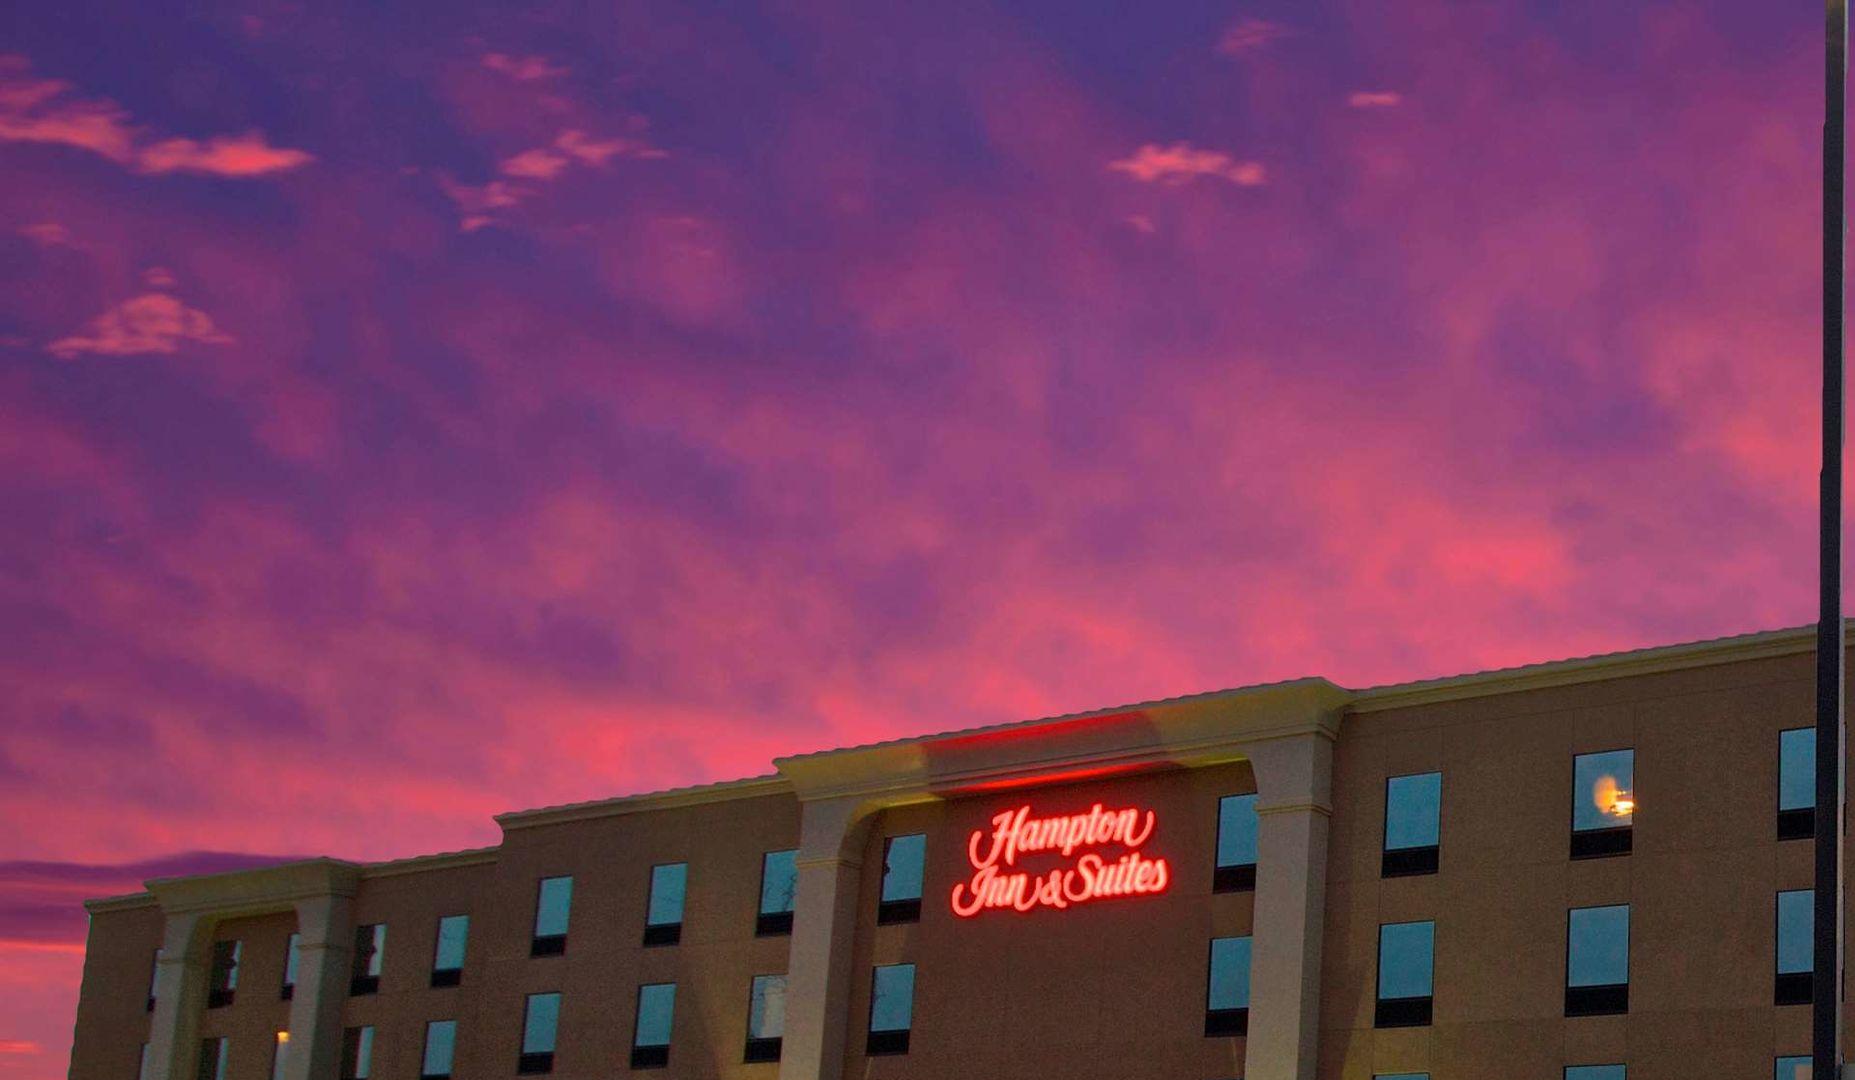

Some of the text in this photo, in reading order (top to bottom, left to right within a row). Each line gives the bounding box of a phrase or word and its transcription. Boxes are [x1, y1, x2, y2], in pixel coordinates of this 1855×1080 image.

[969, 804, 1154, 869] Hampton
[952, 852, 1168, 916] Inn & Suites
